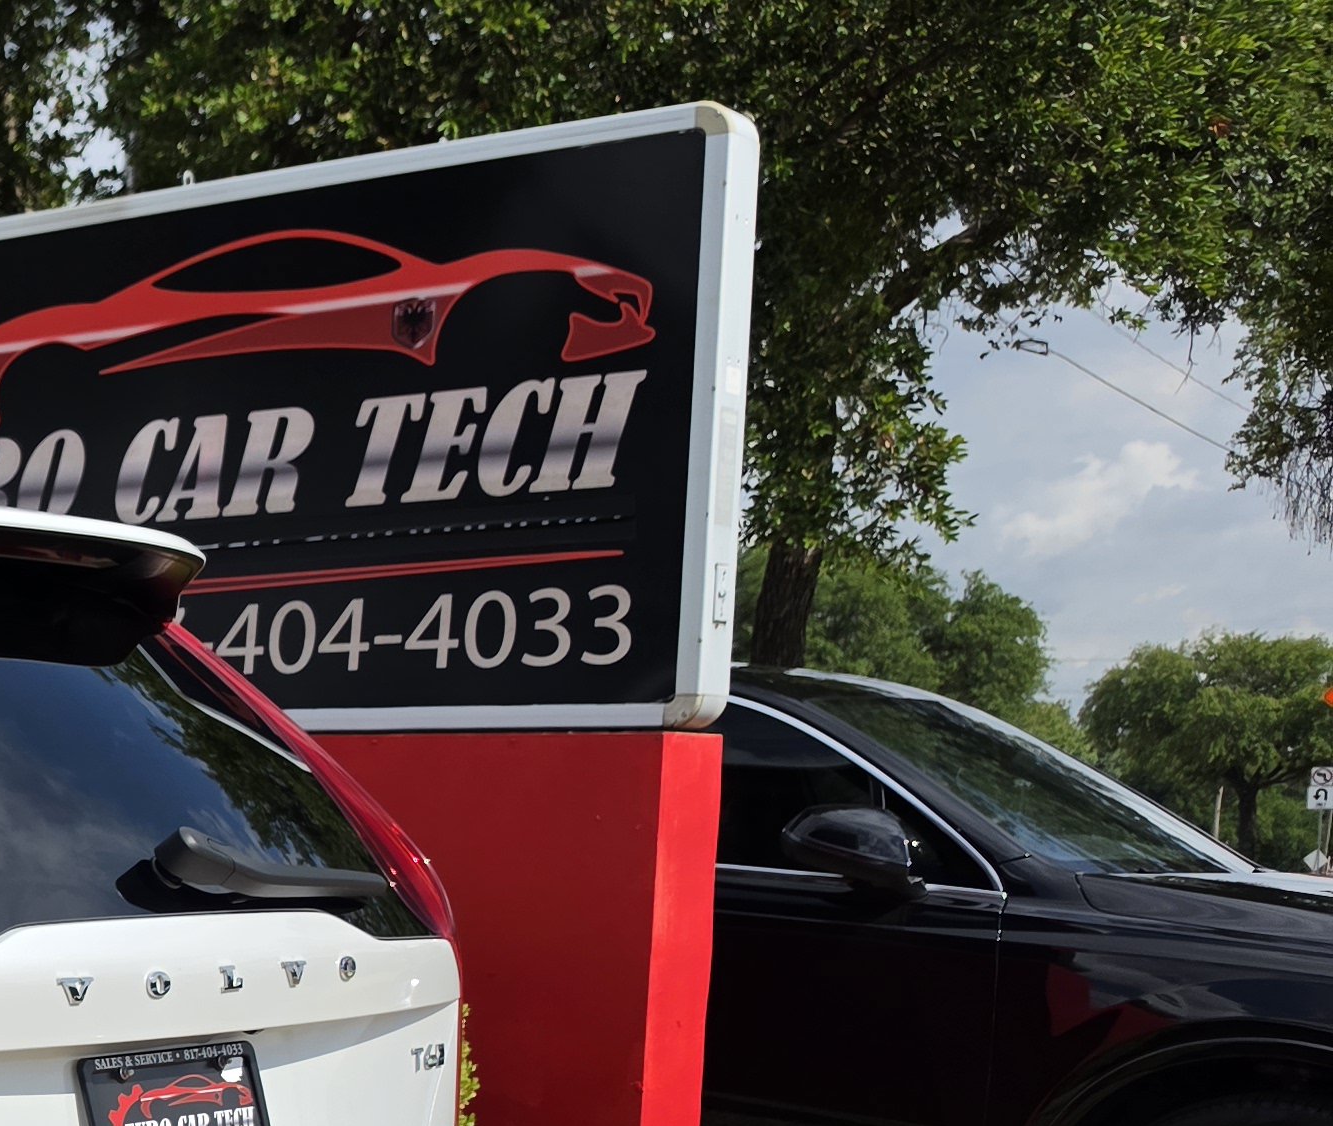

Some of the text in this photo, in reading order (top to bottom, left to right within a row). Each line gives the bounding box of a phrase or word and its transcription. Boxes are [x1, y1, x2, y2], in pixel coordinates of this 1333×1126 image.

[114, 406, 315, 525] CAR
[344, 369, 647, 508] TECH
[56, 956, 357, 1006] VOLVO
[95, 1043, 243, 1070] SALES & SERVICE 817-404-4033
